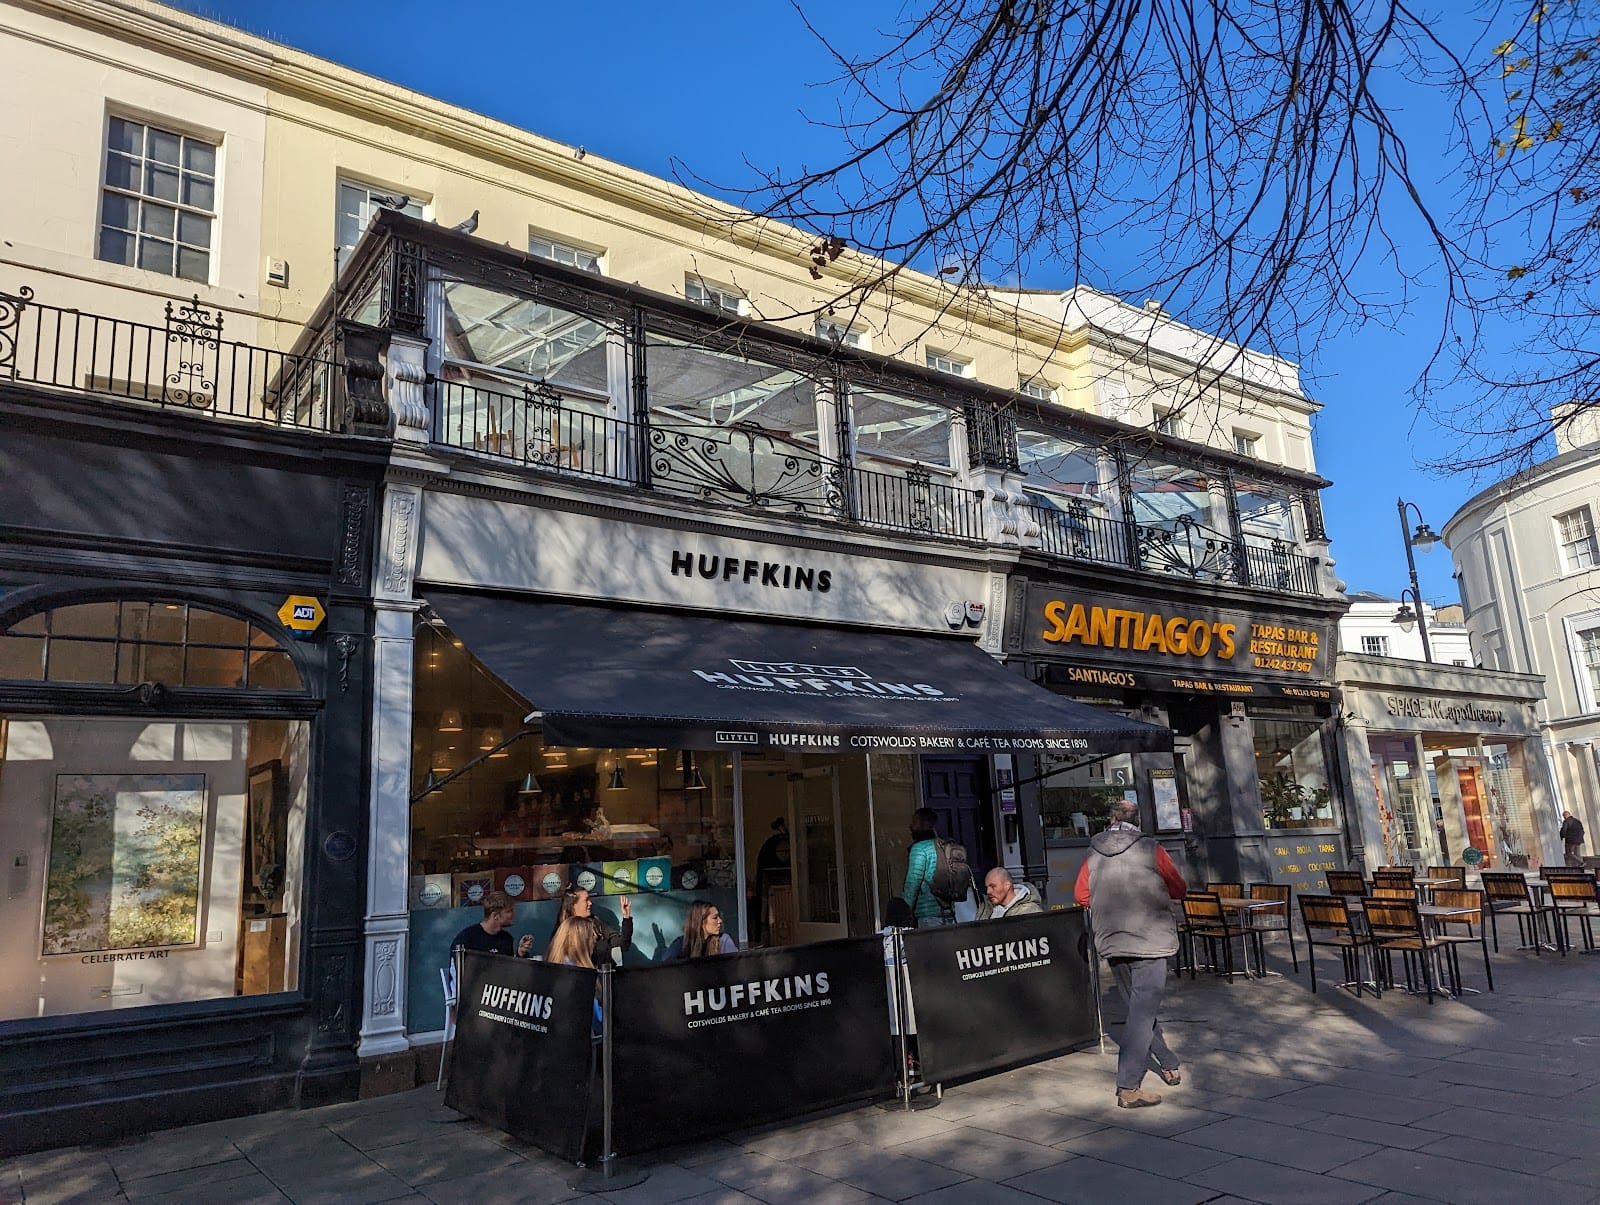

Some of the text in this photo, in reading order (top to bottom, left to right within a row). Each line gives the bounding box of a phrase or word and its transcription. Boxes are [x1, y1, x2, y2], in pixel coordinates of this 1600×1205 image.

[670, 550, 833, 593] HUFFKINS
[294, 607, 315, 619] ADT
[1042, 600, 1236, 660] SANTIAGO'S
[1251, 624, 1319, 645] TAPAS BAR &
[1250, 640, 1319, 660] RESTAURANT
[746, 663, 858, 677] LITTLE
[1255, 657, 1312, 673] 01242 437 967
[692, 669, 945, 697] HUFFKINS
[1068, 667, 1136, 687] SANTIAGO'S
[1172, 679, 1194, 689] TAPAS
[1194, 681, 1208, 690] BAR
[1214, 683, 1254, 693] RESTAURANT
[719, 733, 1088, 749] LITTLE HUFFKINS COTSWOLDS BAKERY & CAFÉ TEA ROOMS SINCE 1890
[1317, 843, 1336, 853] TAPAS
[81, 949, 170, 965] CELEBRATE ART
[955, 936, 1050, 971] HUFFKINS
[480, 983, 553, 1021] HUFFKINS
[683, 971, 830, 1016] HUFFKINS
[687, 1015, 726, 1029] COTSWOLDS
[727, 1011, 750, 1022] BAKERY
[755, 1007, 770, 1017] CAFÉ
[770, 1006, 782, 1015] TEA
[782, 1003, 803, 1013] ROOMS
[803, 1000, 820, 1009] SINCE
